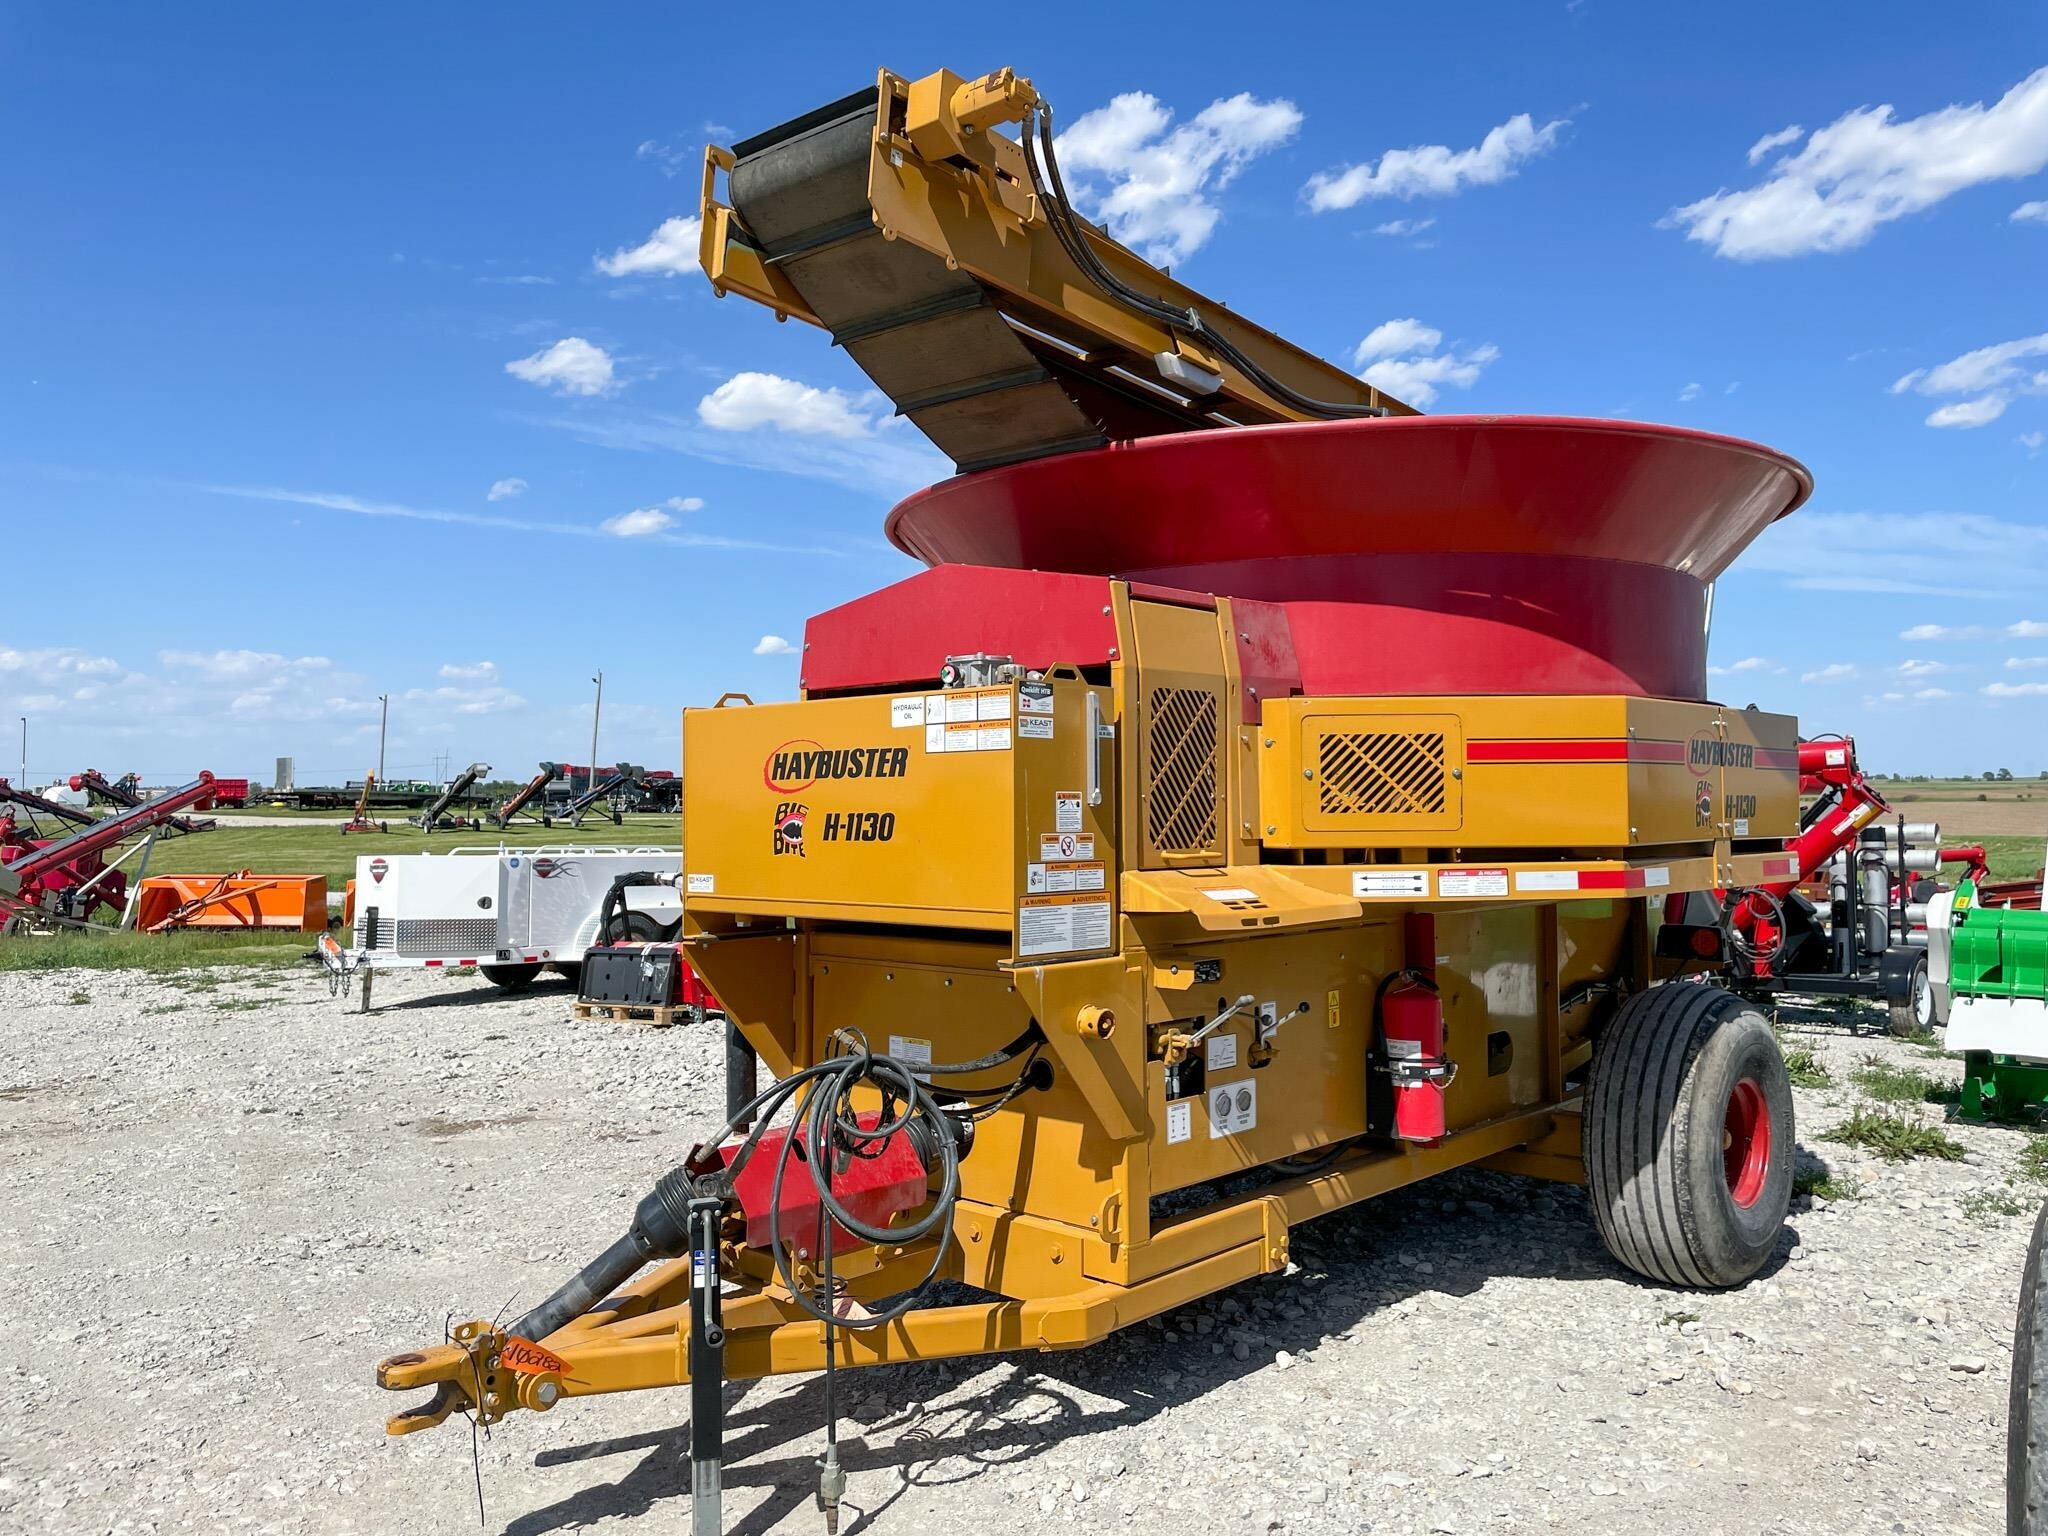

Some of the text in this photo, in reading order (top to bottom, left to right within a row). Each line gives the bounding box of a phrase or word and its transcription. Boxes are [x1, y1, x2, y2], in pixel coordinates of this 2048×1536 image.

[893, 702, 923, 712] HYDRAULIC
[1029, 719, 1053, 727] KEAST
[772, 748, 909, 780] HAYBUSTER
[1690, 740, 1753, 768] HAYBUSTER
[774, 802, 810, 826] BIG
[1725, 794, 1757, 818] H-1130
[823, 812, 895, 842] H-1130
[773, 828, 806, 858] BITE
